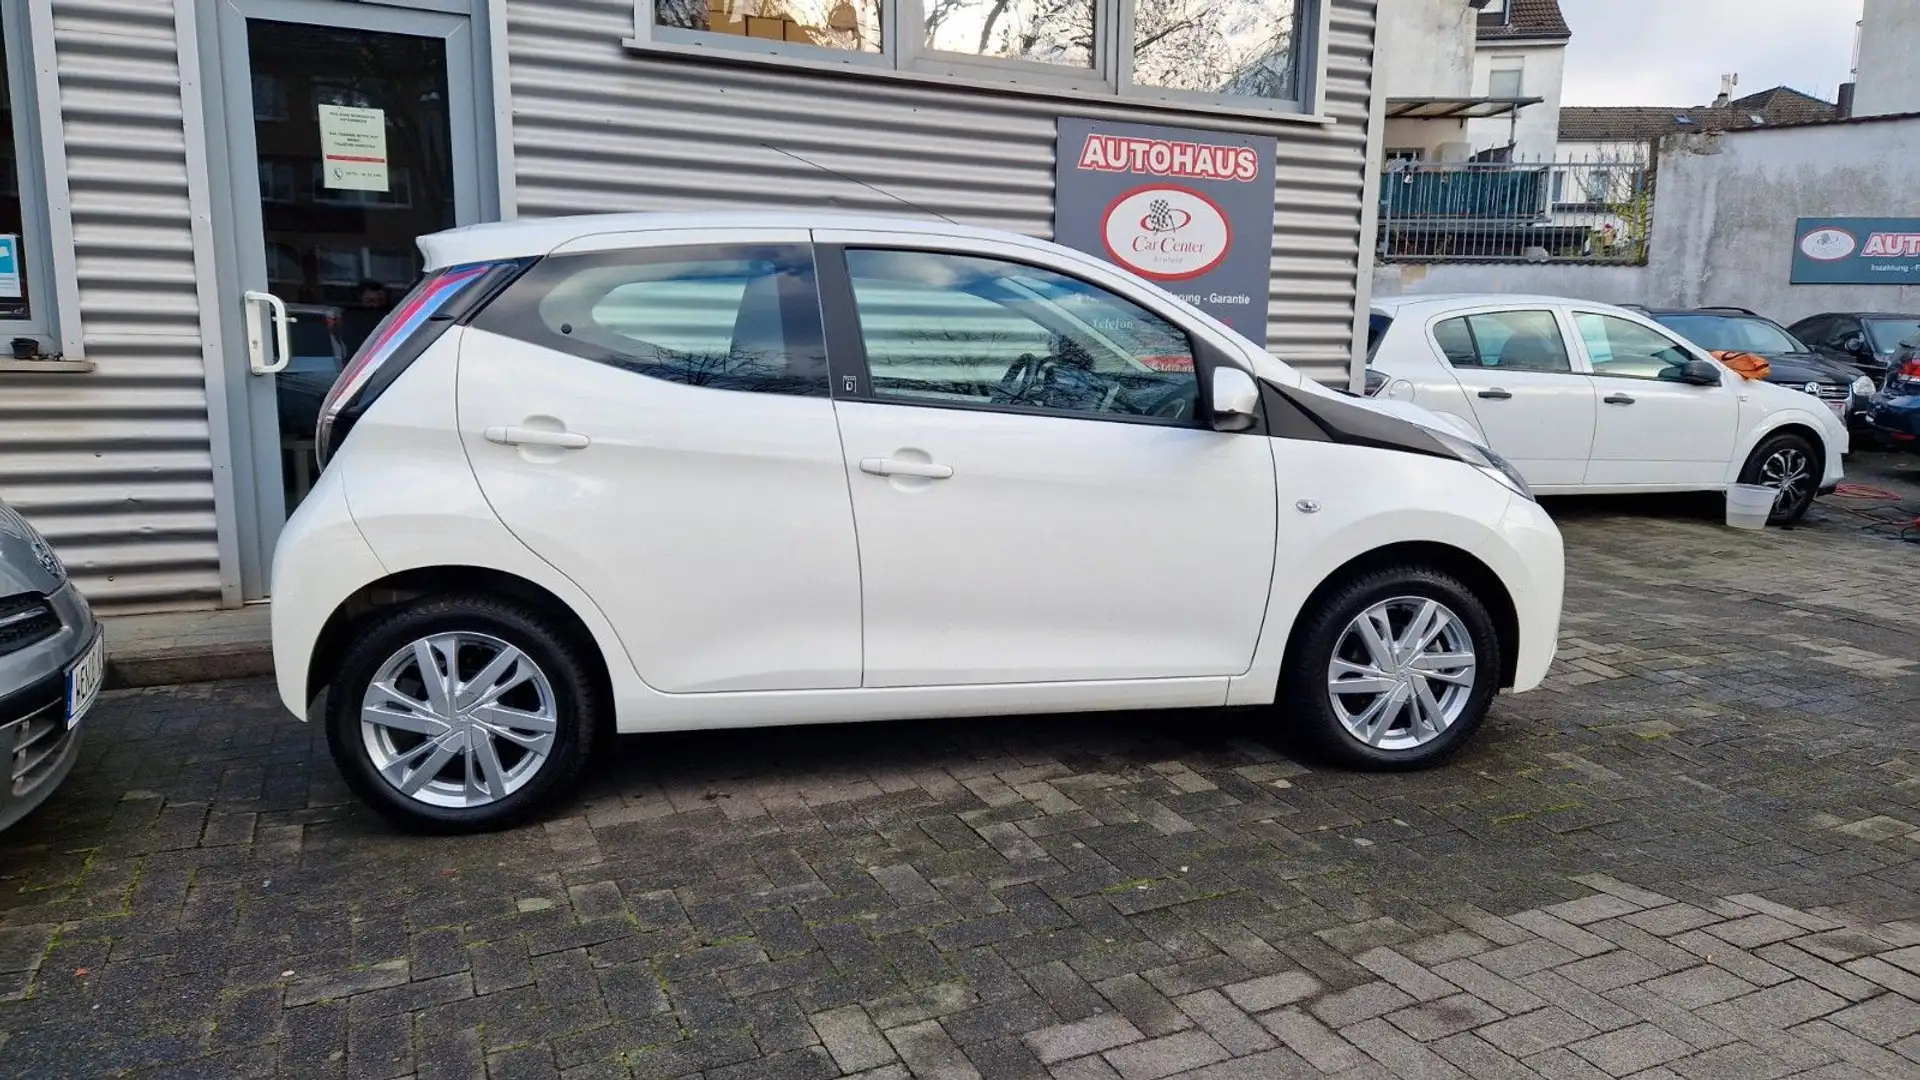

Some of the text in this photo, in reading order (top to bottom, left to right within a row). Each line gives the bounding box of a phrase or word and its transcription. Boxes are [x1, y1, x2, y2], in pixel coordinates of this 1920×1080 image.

[1079, 135, 1258, 181] AUTOHAUS
[1132, 235, 1204, 253] Car Center
[1209, 293, 1251, 305] Garantie
